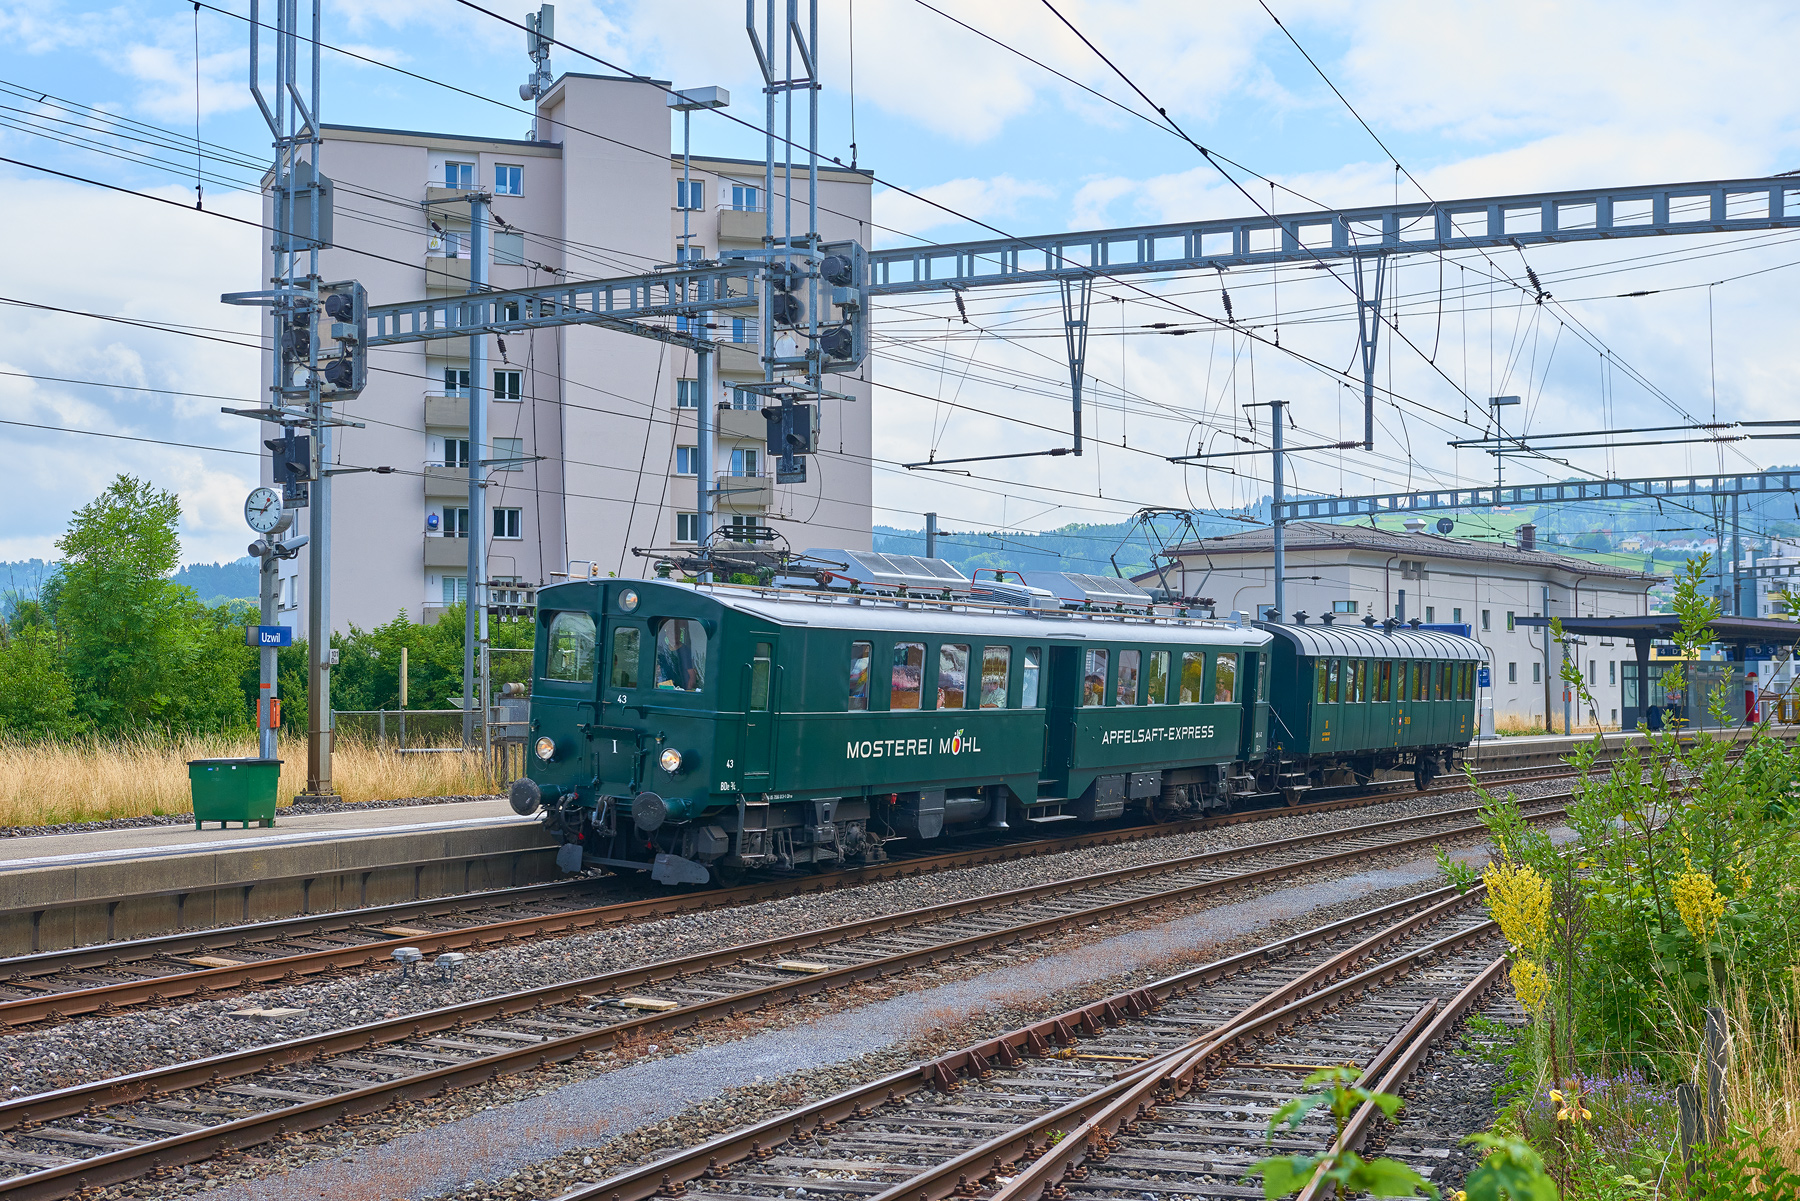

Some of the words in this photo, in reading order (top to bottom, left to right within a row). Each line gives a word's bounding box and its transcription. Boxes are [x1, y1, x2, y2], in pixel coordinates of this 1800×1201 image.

[261, 632, 281, 643] Uzwil
[617, 694, 627, 704] 43
[1102, 725, 1214, 744] APFELSAFT-EXPRESS
[847, 738, 932, 758] MOSTEREI
[939, 729, 981, 755] MÖHL
[726, 760, 734, 768] 43
